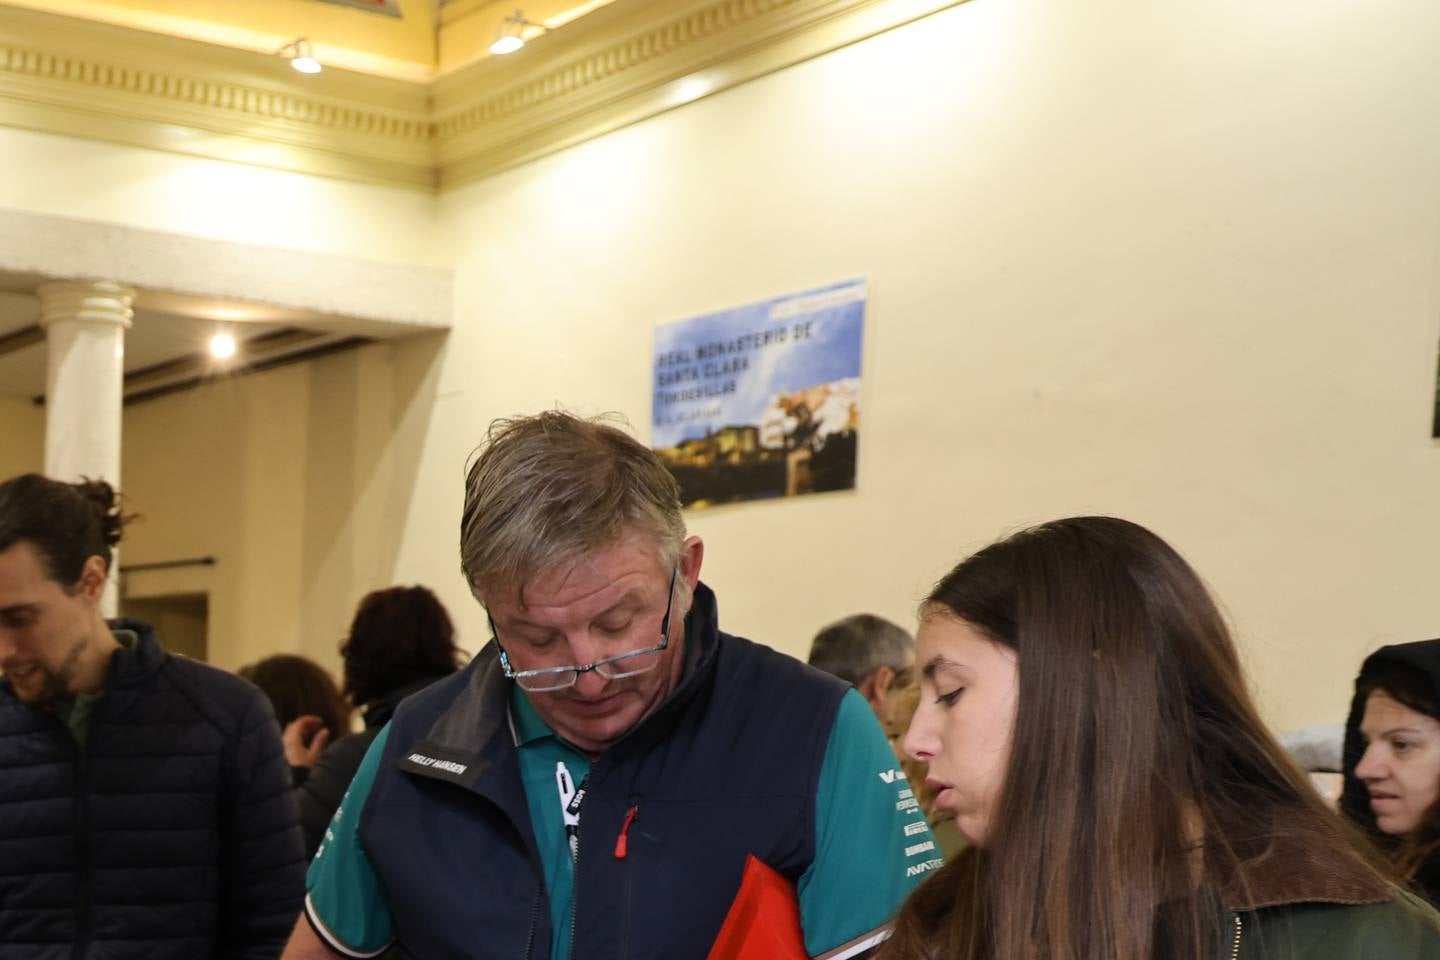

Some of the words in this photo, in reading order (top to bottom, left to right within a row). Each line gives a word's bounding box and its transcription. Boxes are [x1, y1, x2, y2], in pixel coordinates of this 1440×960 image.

[697, 328, 789, 360] MONASTERIO
[794, 321, 814, 341] DE
[657, 366, 700, 387] SANTA
[704, 356, 750, 379] CLARA
[655, 380, 737, 405] TORDESILLAS
[408, 752, 436, 768] HELLY
[432, 758, 468, 775] HANSEN
[570, 788, 587, 809] BOSS
